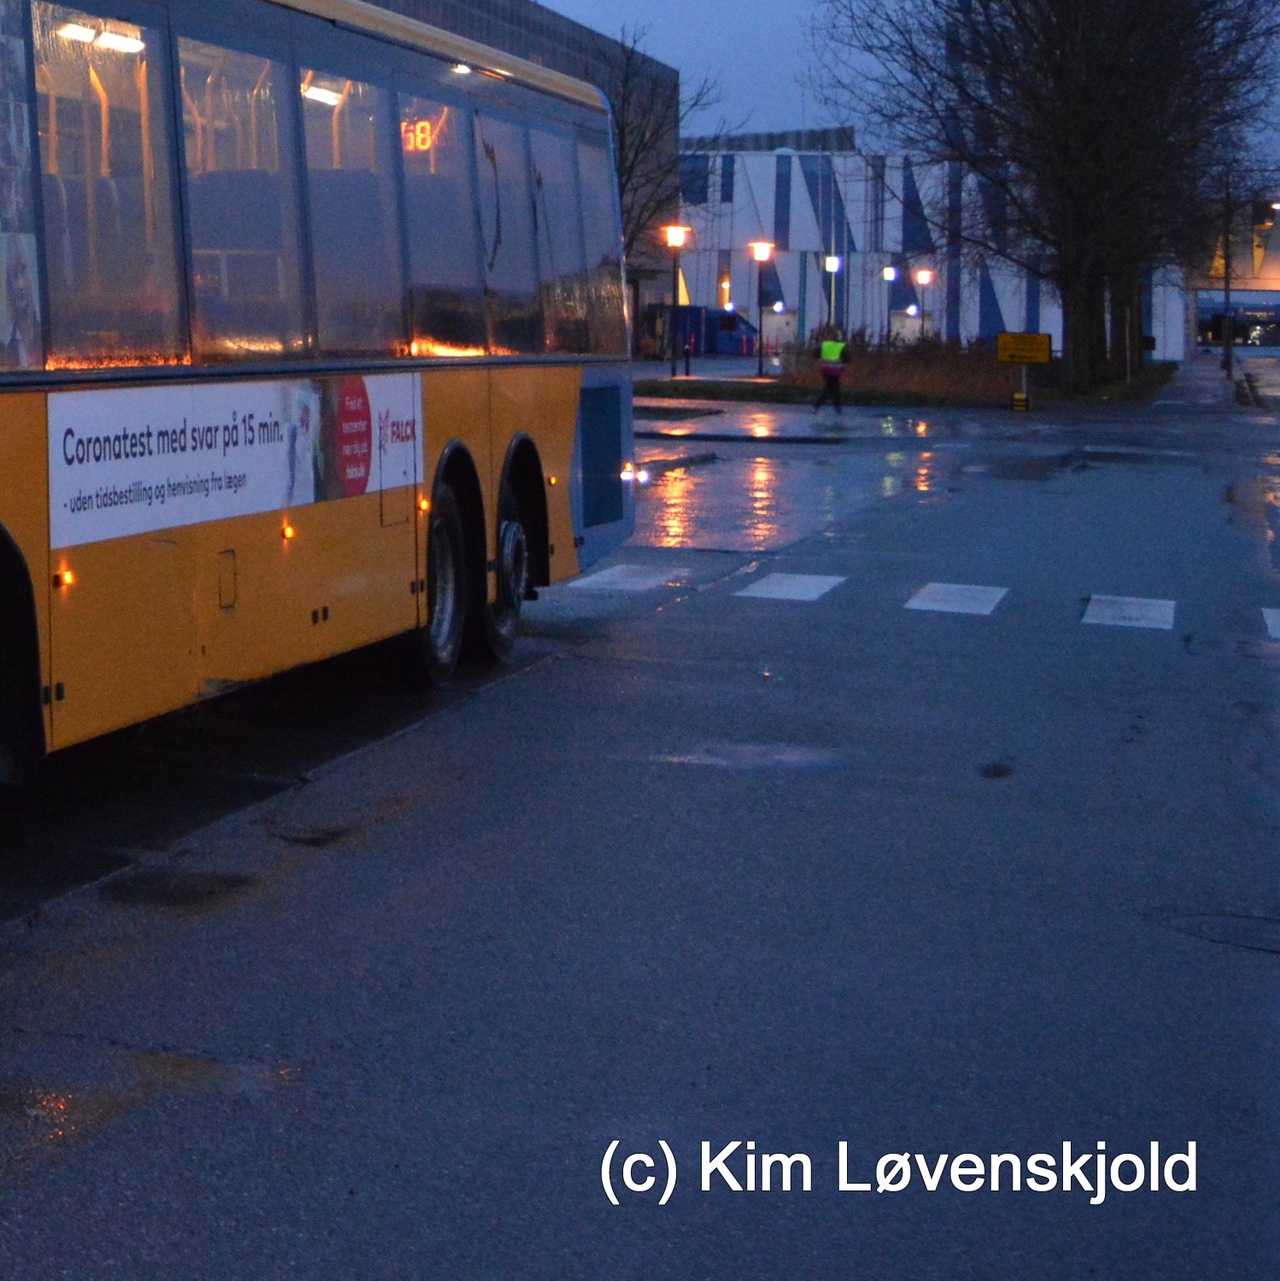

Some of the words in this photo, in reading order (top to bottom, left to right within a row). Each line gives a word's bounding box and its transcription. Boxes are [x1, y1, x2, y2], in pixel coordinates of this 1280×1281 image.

[62, 425, 153, 466] Coronatest
[156, 418, 187, 455] med
[191, 423, 219, 452] svar
[223, 410, 239, 457] på
[242, 414, 255, 447] 15
[258, 411, 284, 445] min.
[390, 419, 417, 444] FALCK
[69, 489, 93, 514] uden
[95, 477, 153, 510] tidsbestilling
[154, 482, 166, 506] og
[166, 473, 210, 500] henvisning
[210, 470, 223, 492] fra
[223, 470, 248, 496] lægen
